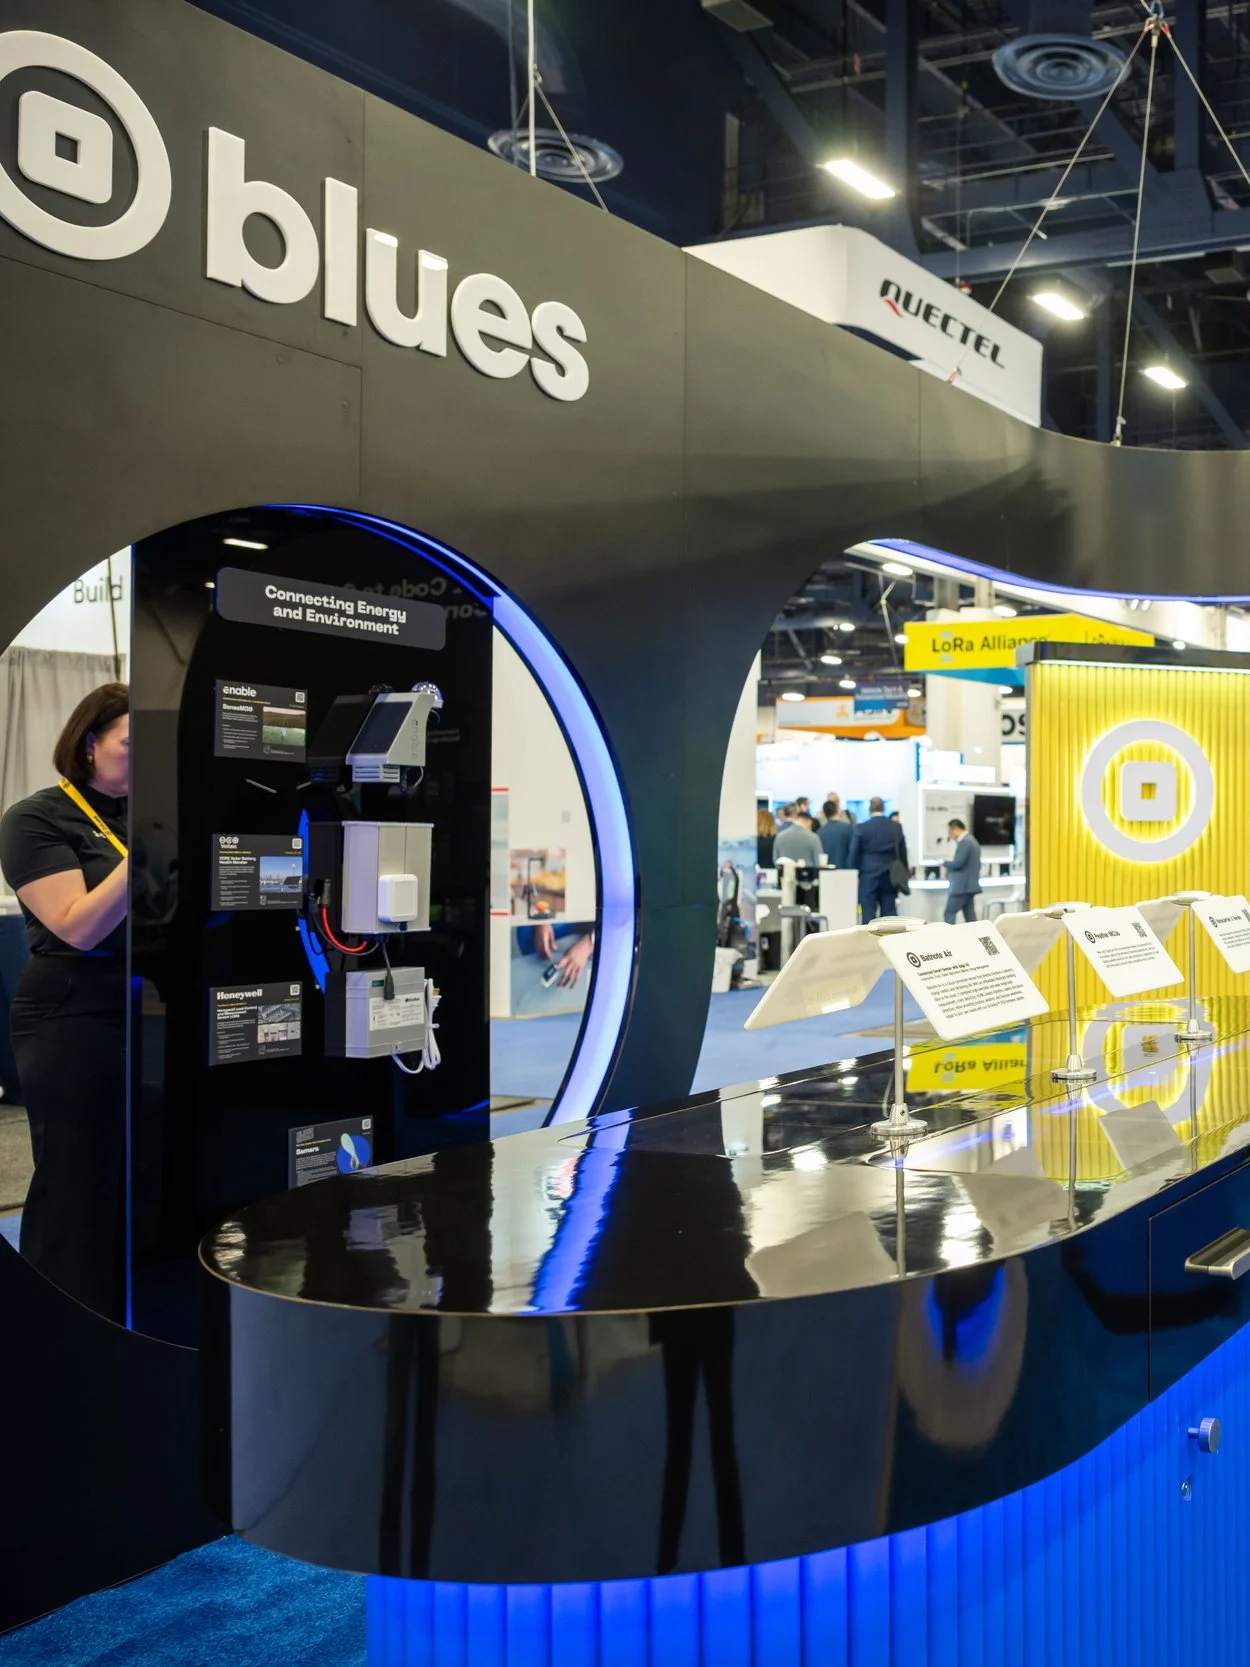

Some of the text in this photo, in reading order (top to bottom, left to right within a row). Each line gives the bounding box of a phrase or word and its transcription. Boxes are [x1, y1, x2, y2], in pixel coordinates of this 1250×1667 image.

[206, 126, 590, 402] blues
[879, 277, 1006, 370] QUECTEL
[73, 574, 123, 604] Build
[264, 584, 407, 624] Connecting Energy
[272, 604, 400, 635] and Environment
[931, 637, 974, 653] LoRa
[222, 685, 257, 698] enable
[919, 949, 953, 963] Batnote Air
[216, 988, 263, 1001] Honeywell
[295, 1146, 320, 1156] Samara
